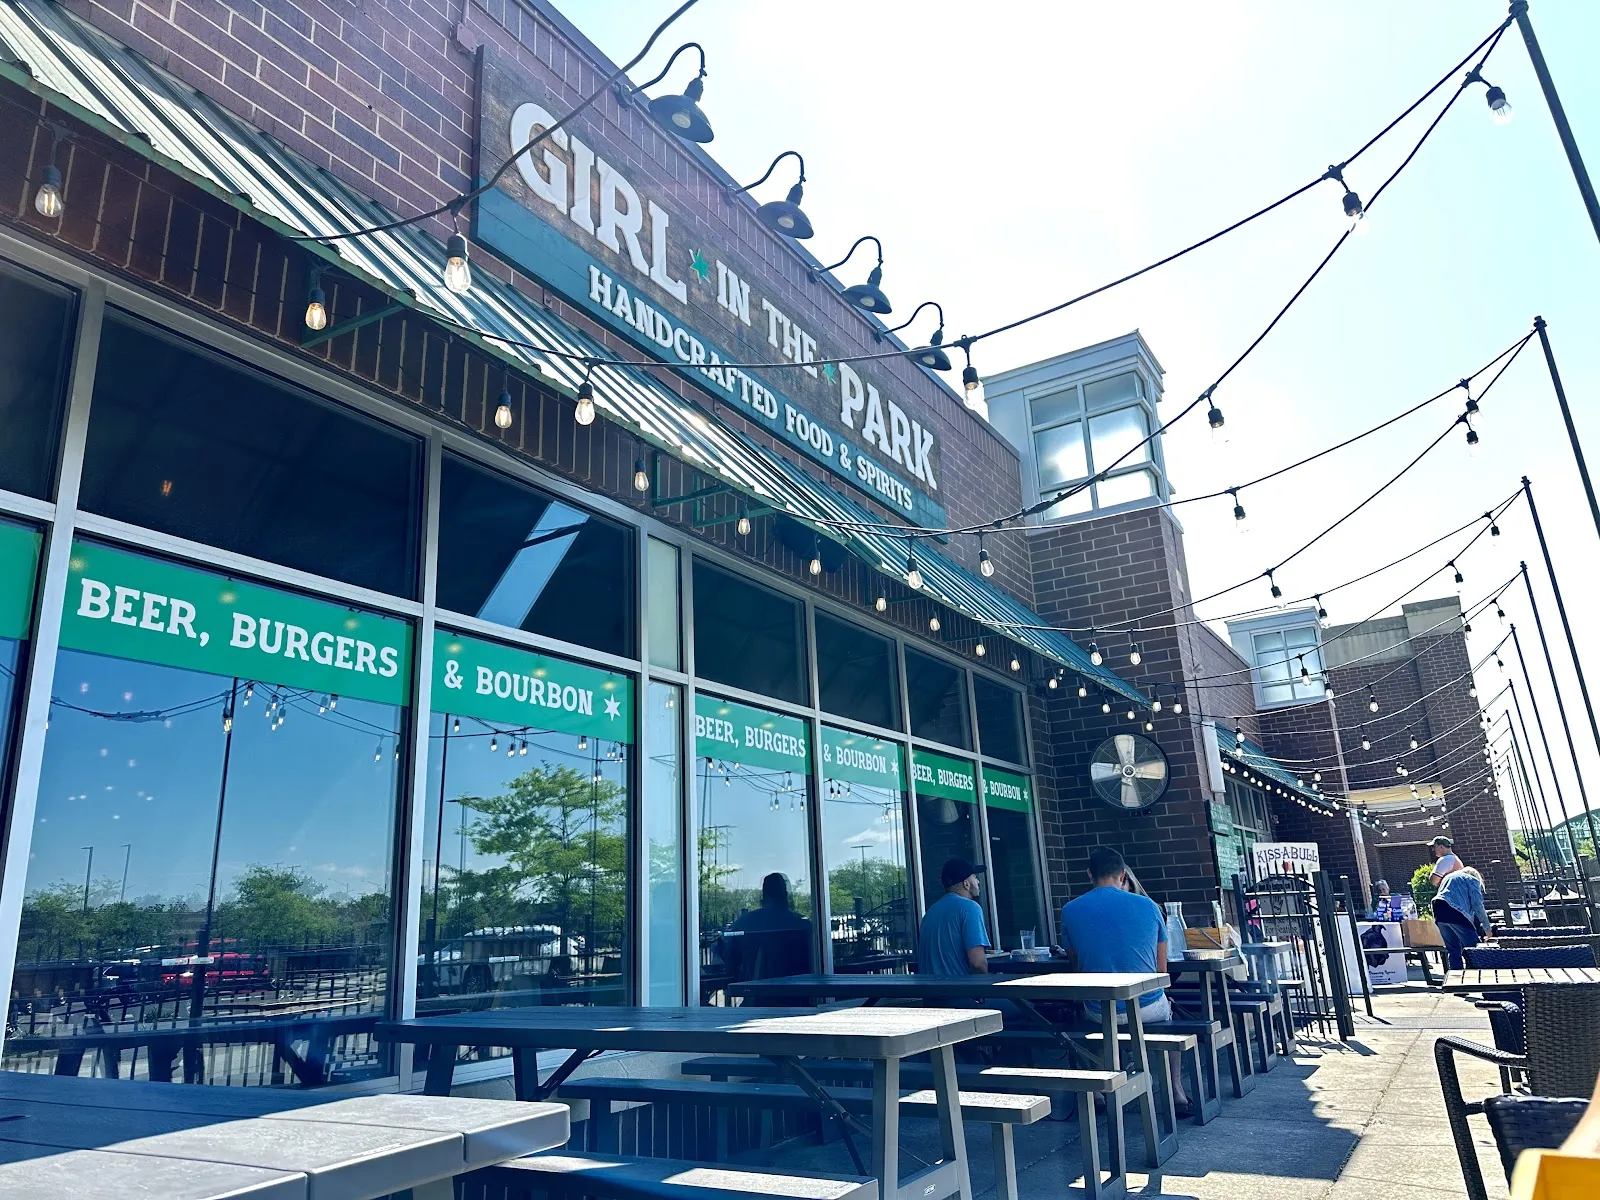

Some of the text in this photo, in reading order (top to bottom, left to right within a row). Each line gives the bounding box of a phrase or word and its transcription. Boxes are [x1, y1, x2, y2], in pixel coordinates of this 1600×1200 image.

[510, 102, 938, 491] GIRL IN THE PARK
[588, 264, 914, 511] HANDCRAFTED FOOD & SPIRITS
[76, 577, 400, 679] BEER, BURGERS
[443, 659, 594, 717] & BOURBON
[695, 714, 806, 759] BEER, BURGERS
[823, 743, 887, 775] & BOURBON
[912, 763, 974, 791] BEER, BURGERS
[990, 781, 1021, 800] BOURBON
